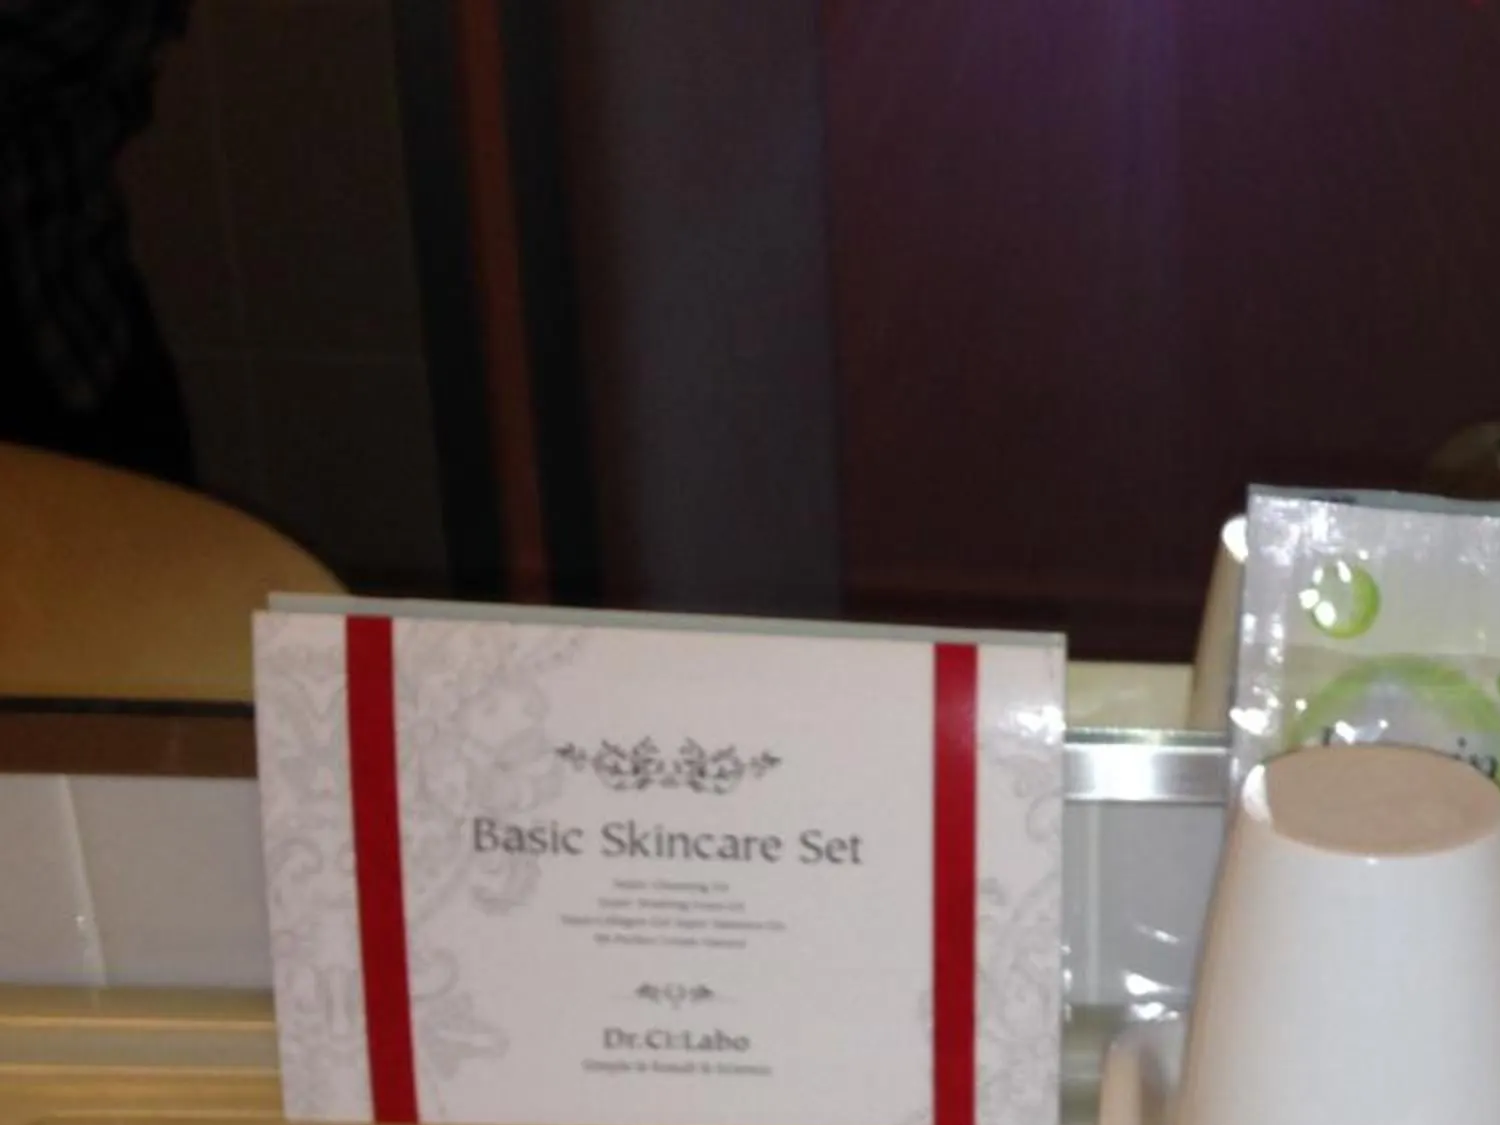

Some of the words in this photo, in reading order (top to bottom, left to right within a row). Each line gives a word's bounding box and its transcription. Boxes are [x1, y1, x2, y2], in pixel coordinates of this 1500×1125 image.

[473, 816, 585, 856] Basic
[600, 820, 784, 864] Skincare
[798, 828, 865, 866] Set
